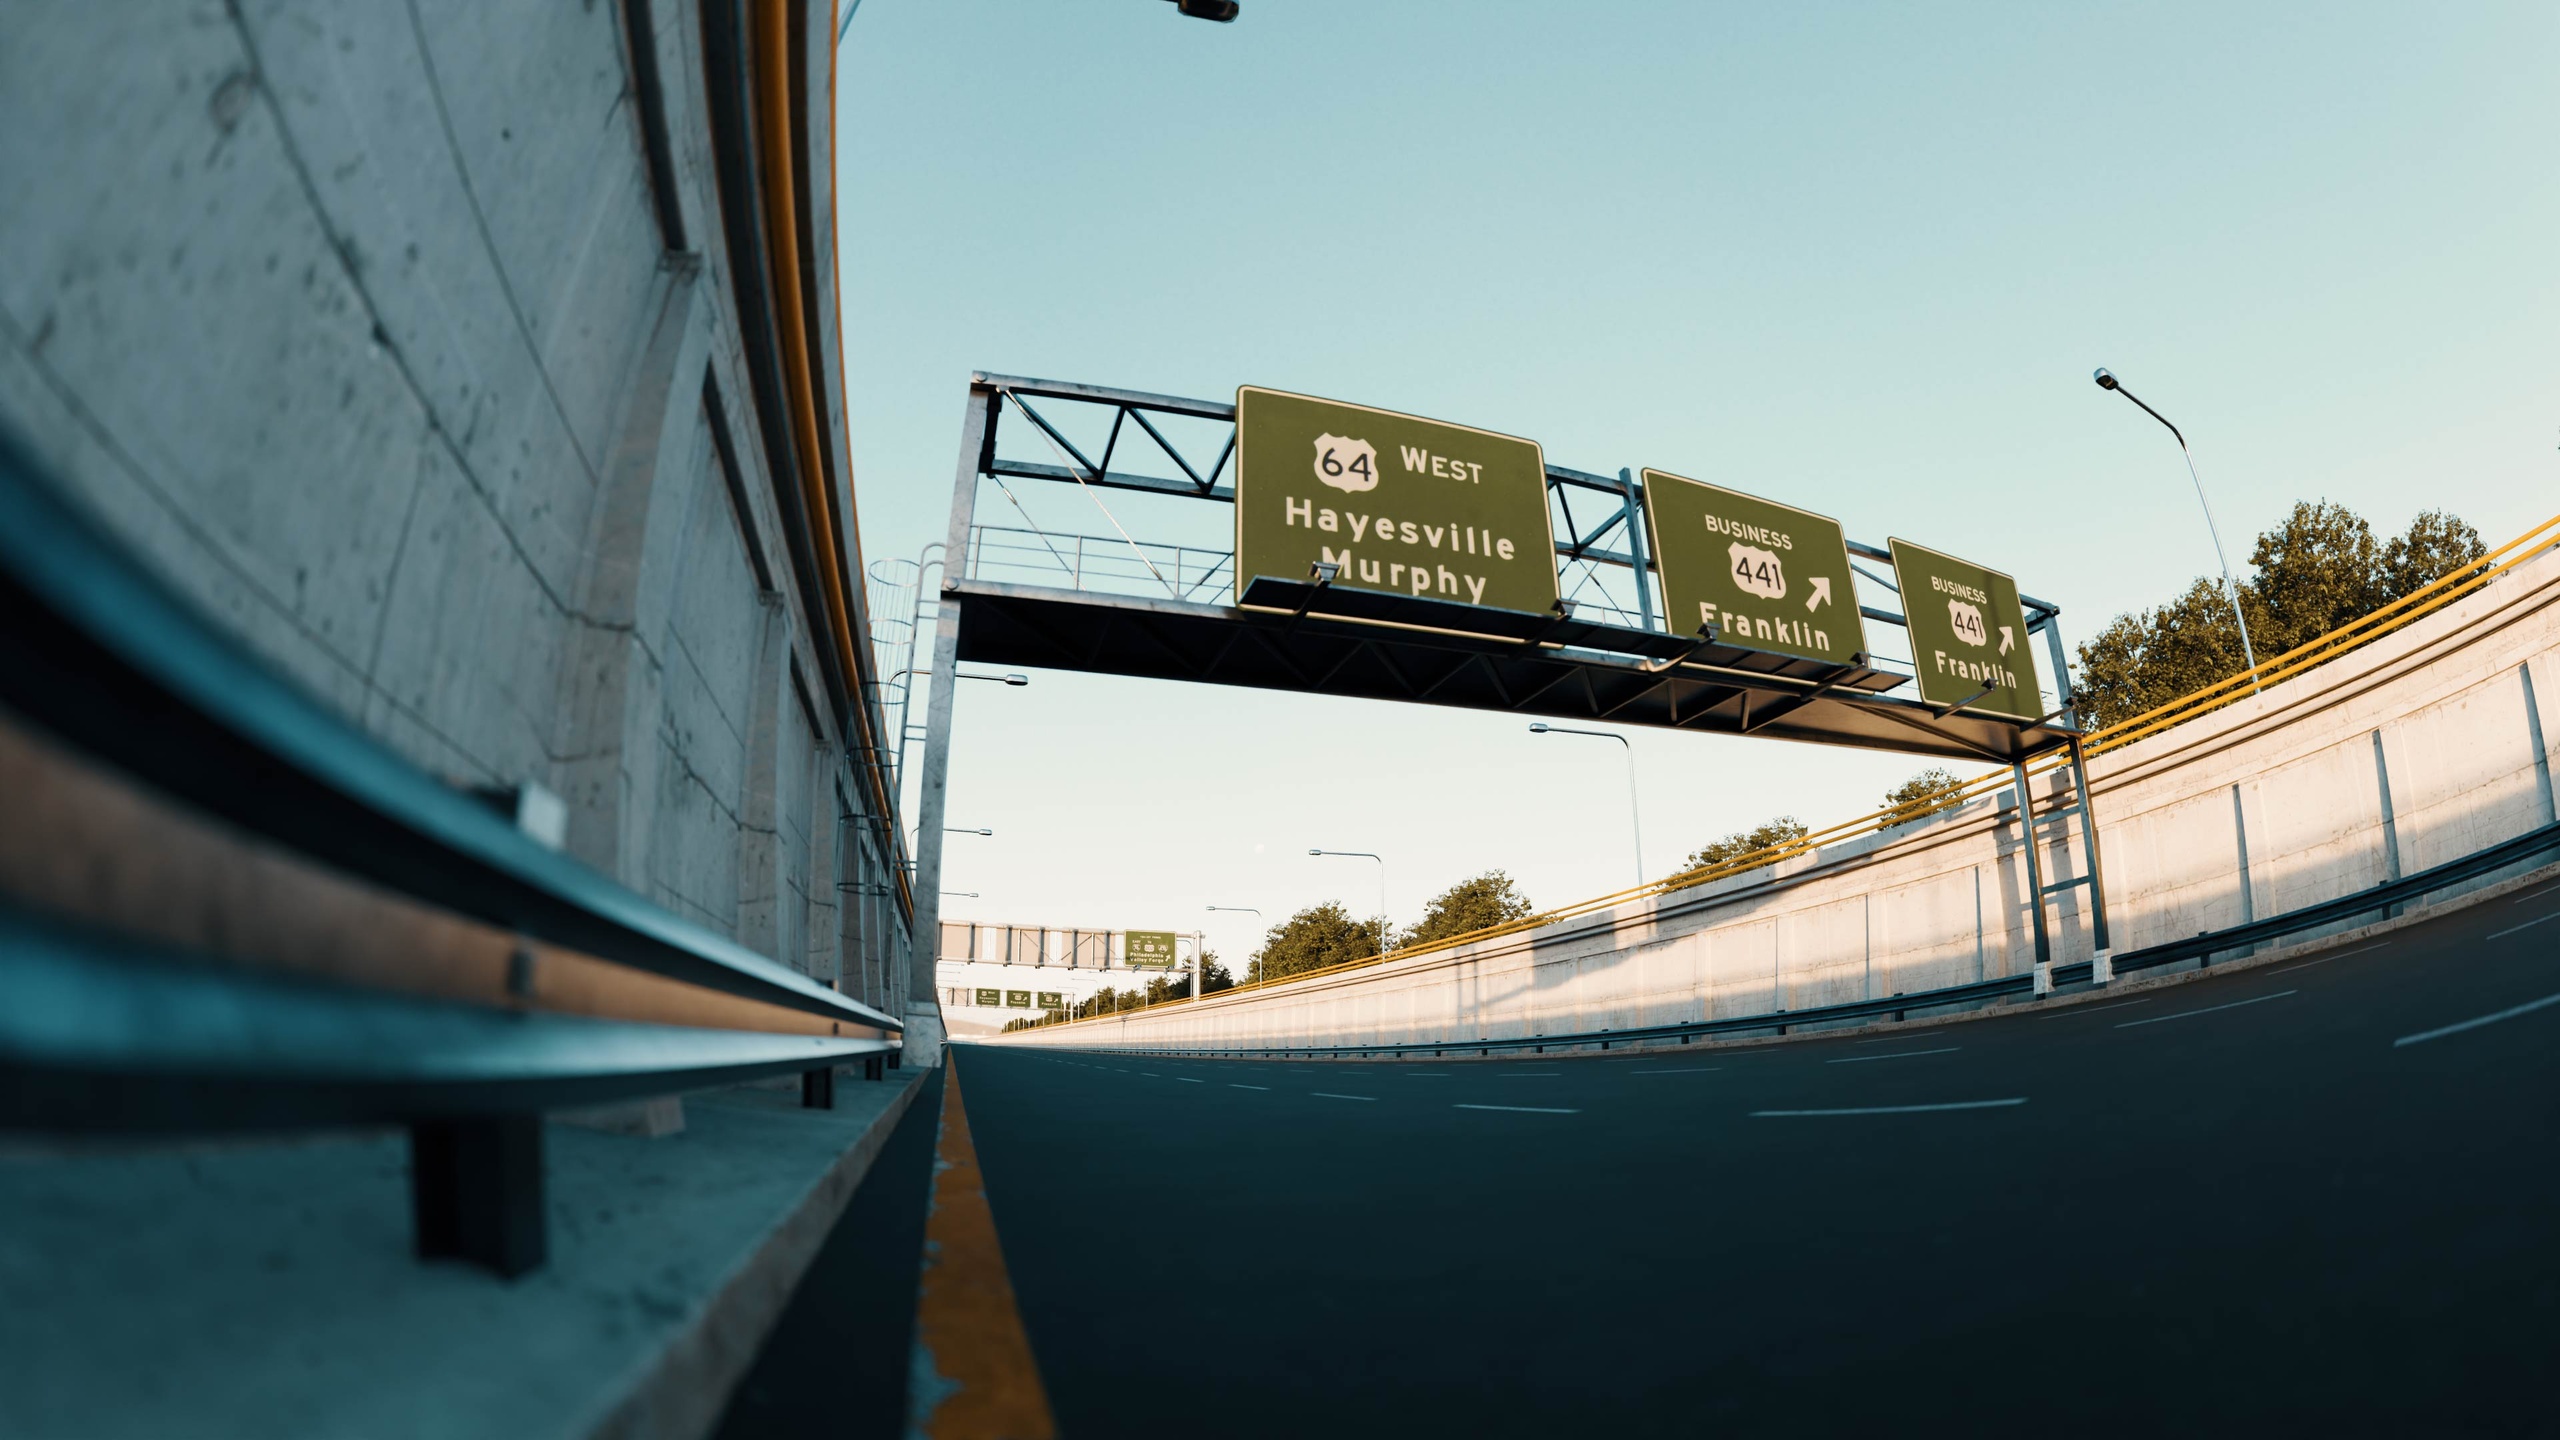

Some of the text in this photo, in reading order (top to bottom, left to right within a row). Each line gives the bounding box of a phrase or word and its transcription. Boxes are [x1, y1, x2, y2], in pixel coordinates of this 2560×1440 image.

[1321, 447, 1372, 483] 64
[1400, 445, 1483, 484] WEST
[1285, 496, 1516, 561] Hayesville
[1705, 514, 1793, 551] BUSINESS
[1321, 546, 1487, 605] Murphy
[1736, 556, 1782, 591] 441
[1931, 575, 1988, 605] BUSINESS
[1699, 601, 1830, 652] Franklin
[1954, 611, 1984, 640] 441
[1934, 650, 2017, 689] Franklin
